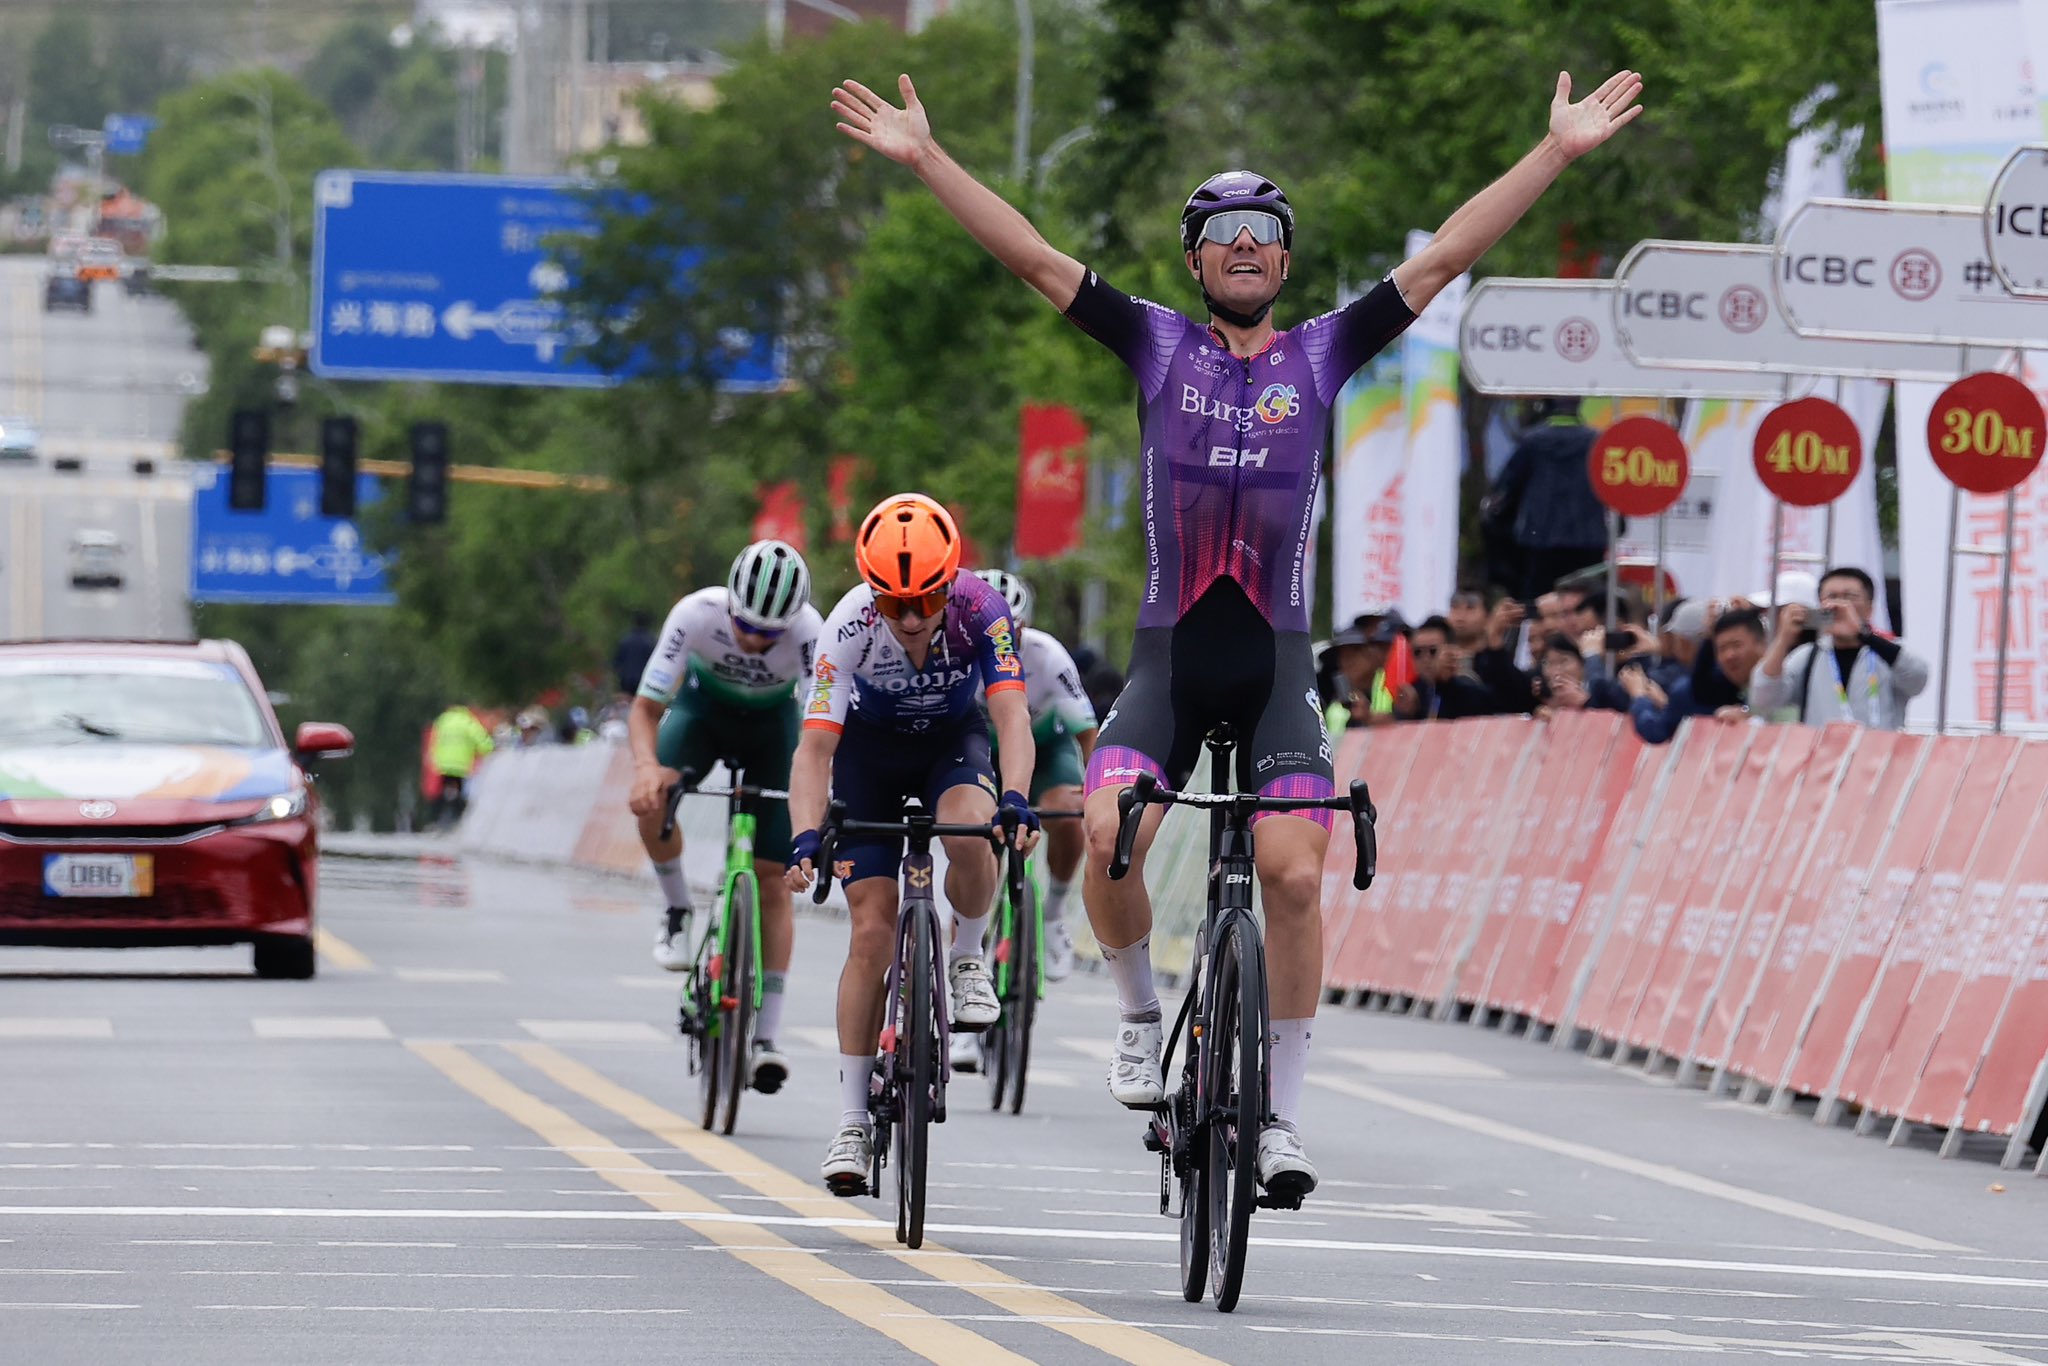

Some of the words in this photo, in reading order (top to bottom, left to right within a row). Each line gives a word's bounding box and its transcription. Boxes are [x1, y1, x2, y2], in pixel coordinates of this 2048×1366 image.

[1784, 254, 1876, 287] ICBC
[1624, 291, 1707, 320] ICBC
[1469, 326, 1546, 351] ICBC
[1765, 429, 1850, 475] 40M
[1940, 407, 2034, 459] 30M
[1146, 447, 1154, 501] BURGOS
[1208, 446, 1269, 468] BH
[1309, 449, 1320, 491] HOTEL
[1601, 446, 1679, 488] 50M
[1146, 502, 1154, 519] DE
[1300, 494, 1313, 540] CIUDAD
[1147, 521, 1159, 565] CIUDAD
[1295, 542, 1304, 558] DE
[1147, 567, 1160, 603] HOTEL
[1290, 560, 1300, 607] BURGOS
[1225, 873, 1251, 885] BH
